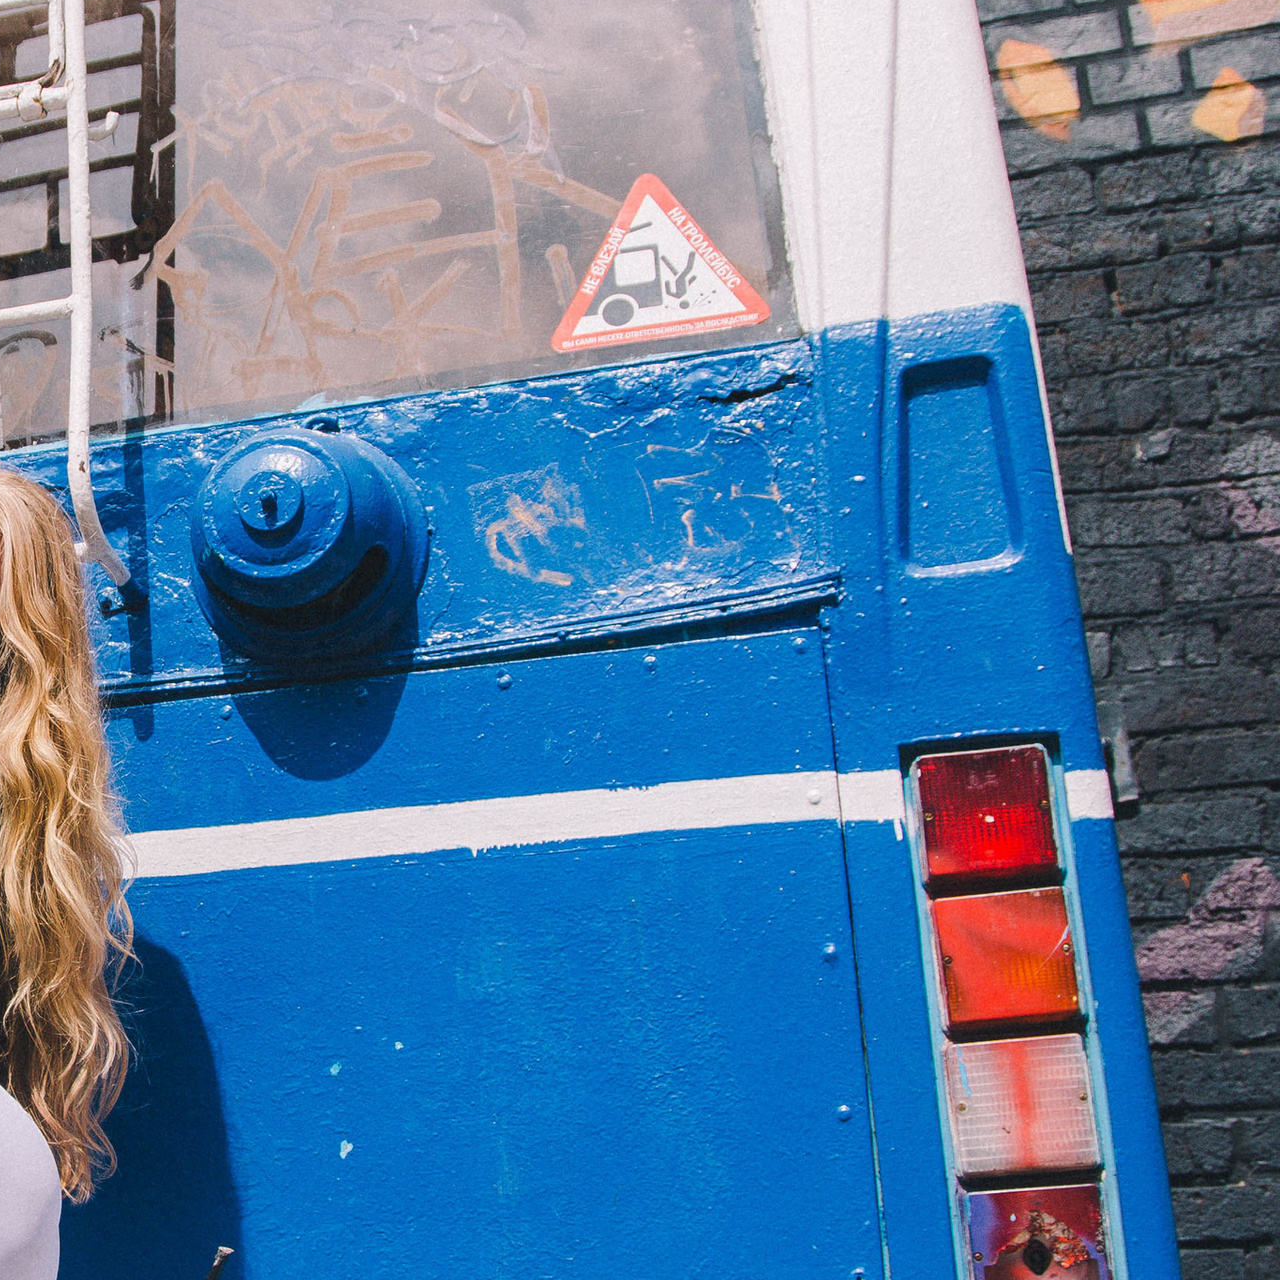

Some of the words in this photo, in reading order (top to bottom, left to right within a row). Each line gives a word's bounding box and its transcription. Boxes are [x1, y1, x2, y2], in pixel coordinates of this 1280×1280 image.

[590, 226, 626, 282] ВЛЕЗАЙ
[667, 206, 688, 227] НА
[679, 221, 742, 289] ТРОЛЛЕЙБУС
[581, 274, 600, 295] НЕ
[575, 336, 597, 346] САМИ
